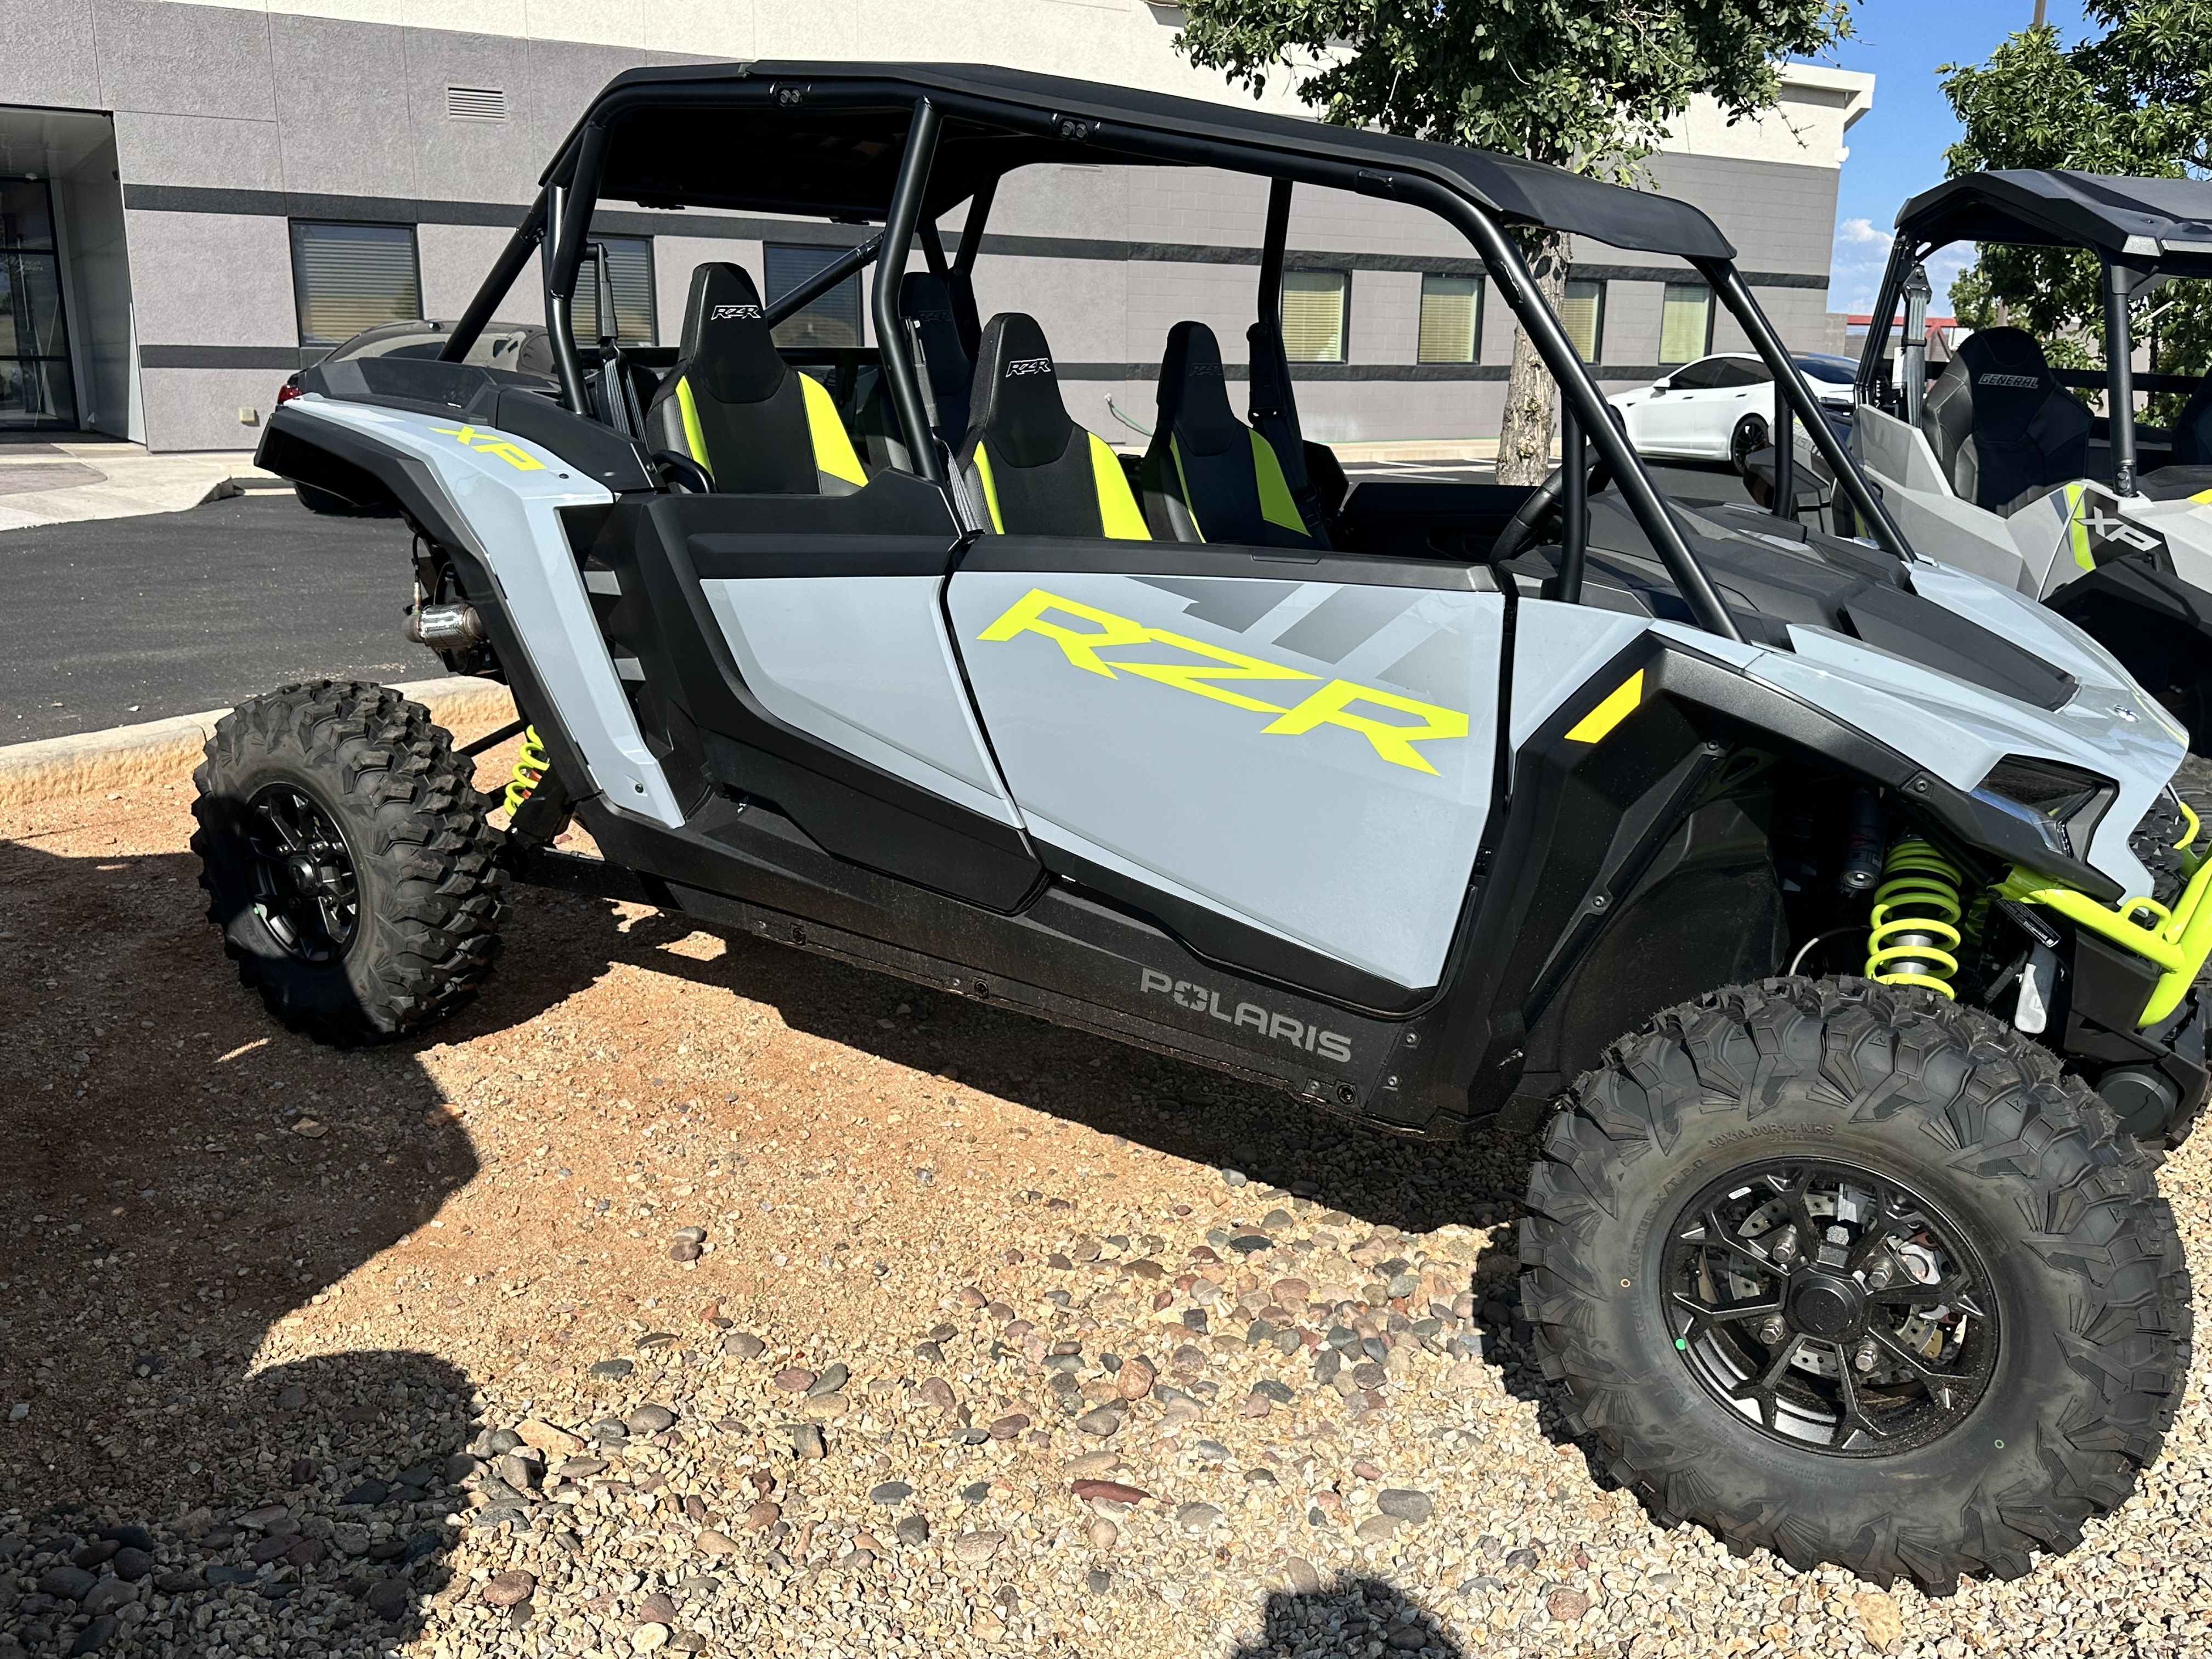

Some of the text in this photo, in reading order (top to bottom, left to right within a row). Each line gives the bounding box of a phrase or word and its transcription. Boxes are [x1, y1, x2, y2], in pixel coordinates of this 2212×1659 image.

[711, 305, 761, 320] RZR
[1005, 358, 1052, 378] RZR
[1188, 363, 1222, 377] RZR
[1978, 373, 2039, 388] GENERAL
[427, 425, 548, 471] XP
[2072, 506, 2163, 551] XP
[976, 588, 1469, 777] RZR
[1139, 967, 1352, 1062] POLARIS
[1800, 1122, 1833, 1136] NHS
[1652, 1177, 1680, 1206] X/T
[1680, 1159, 1703, 1177] 2.0
